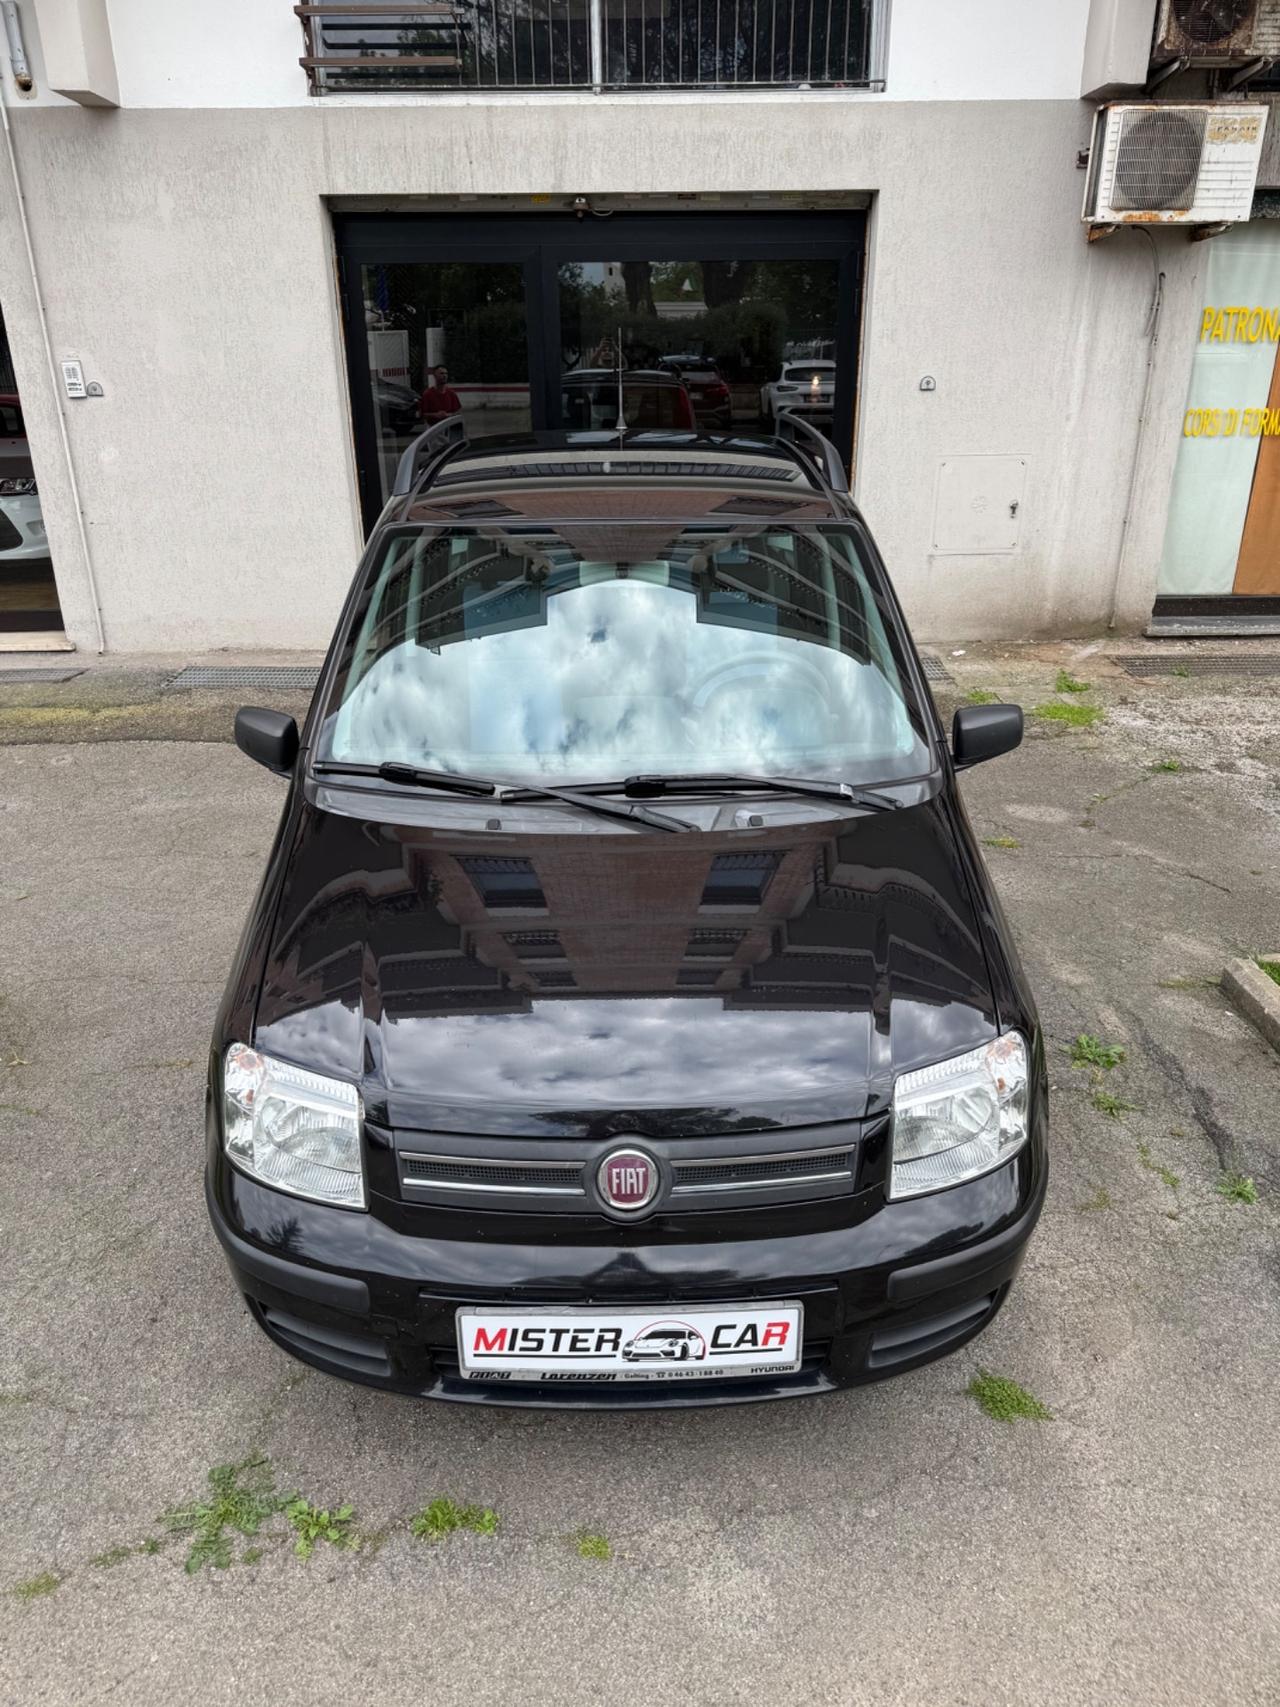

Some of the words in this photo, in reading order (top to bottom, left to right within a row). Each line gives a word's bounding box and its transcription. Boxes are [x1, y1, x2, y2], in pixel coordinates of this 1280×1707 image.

[1200, 306, 1280, 343] PATRON
[1222, 408, 1239, 437] DI
[1240, 408, 1280, 437] FORM
[611, 1168, 646, 1194] FIAT
[473, 1328, 623, 1352] MISTER
[710, 1321, 791, 1348] CAR
[751, 1365, 794, 1373] HYUNDAI
